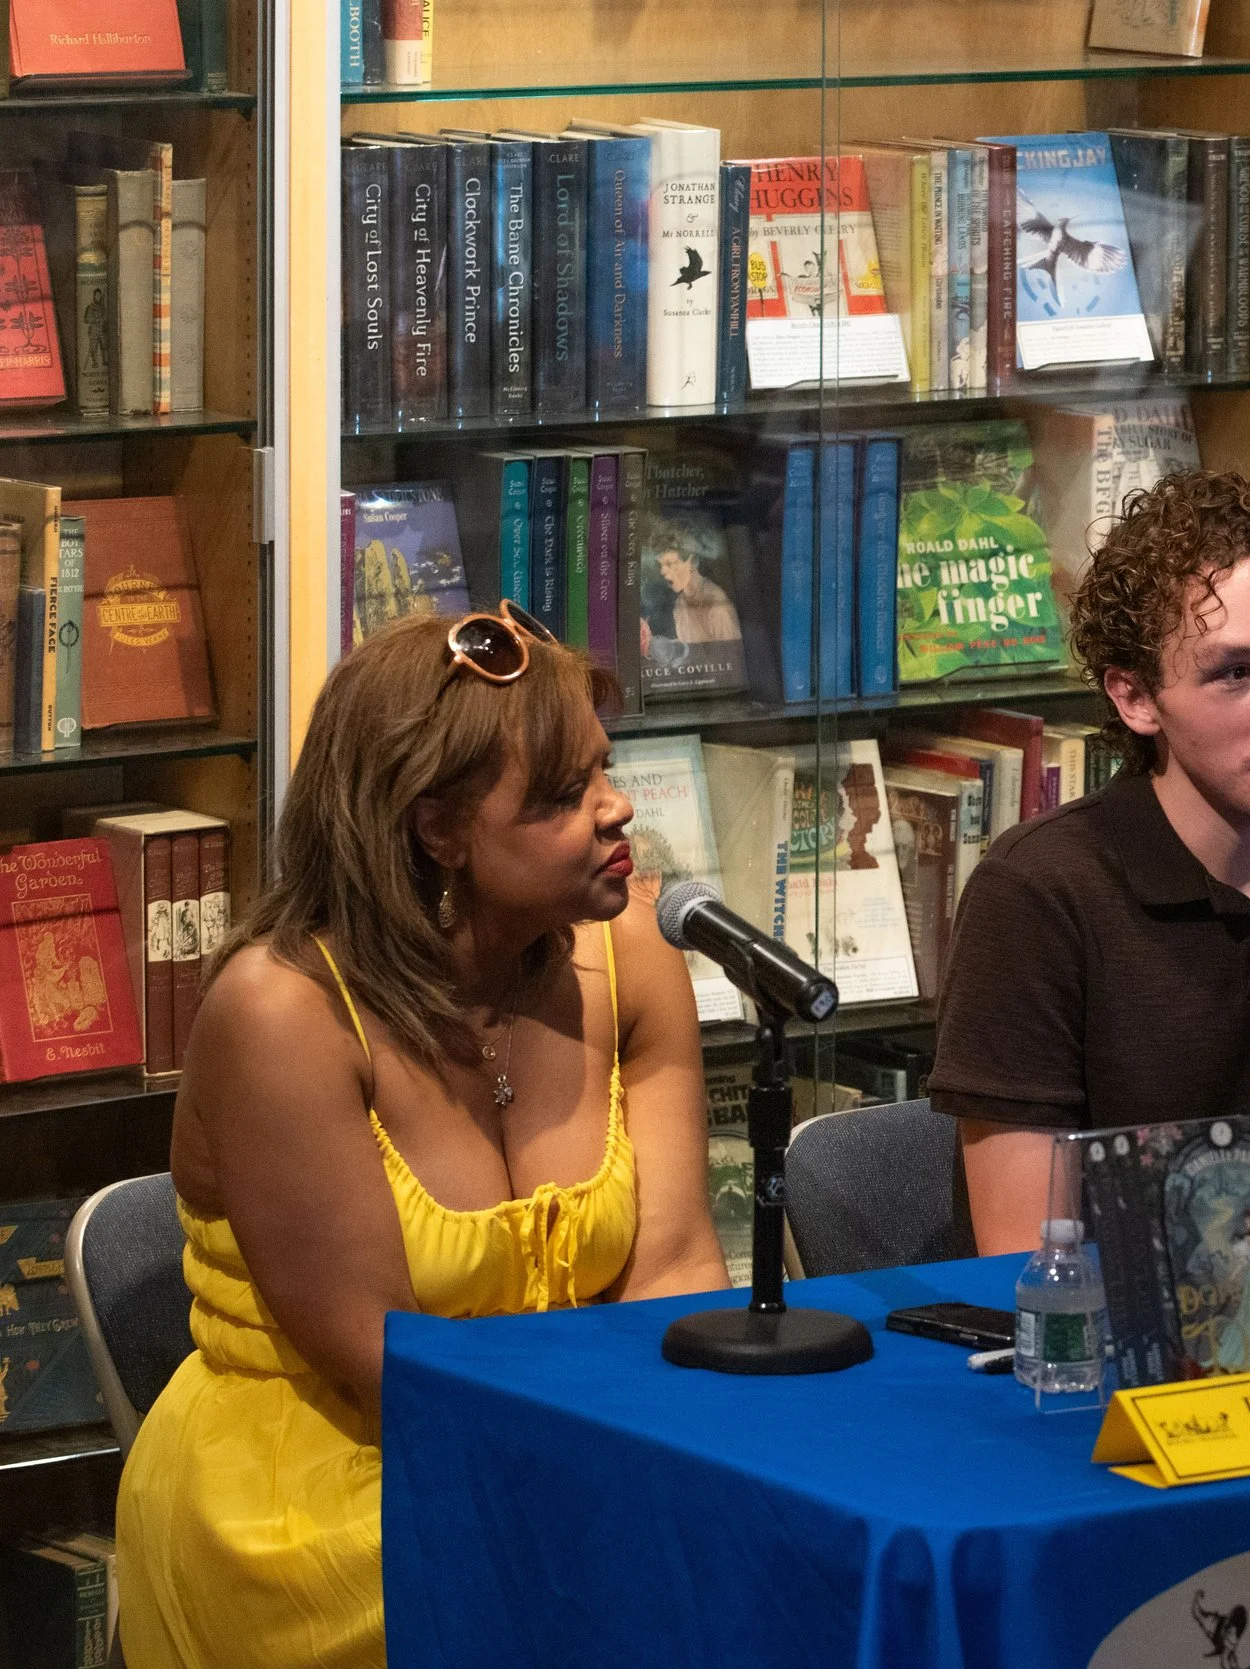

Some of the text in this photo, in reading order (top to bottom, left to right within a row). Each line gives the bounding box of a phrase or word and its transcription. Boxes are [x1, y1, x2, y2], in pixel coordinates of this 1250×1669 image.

[49, 32, 151, 45] Richard Halliburton
[550, 153, 580, 163] CLARE
[1016, 146, 1107, 171] CKINGJAY
[755, 162, 840, 183] HENRY
[663, 182, 716, 193] JONATHAN
[750, 187, 853, 209] HUGGINS
[663, 194, 716, 205] STRANGE
[934, 172, 943, 245] THE PRINCE WAITING
[686, 213, 699, 223] &
[972, 200, 981, 246] THE SPIRITS
[662, 229, 716, 238] Mr NORRELL
[748, 229, 759, 240] by
[763, 225, 812, 237] BEVERLY
[361, 183, 383, 350] City of Lost Souls
[465, 177, 481, 343] Clockwork Prince
[556, 174, 575, 361] Lord of Shadows
[613, 169, 626, 358] Queen of Air and Darkness
[750, 259, 767, 271] BUS
[1003, 209, 1012, 320] CATCHING FIRE
[411, 183, 431, 377] City of Heavenly Fire
[508, 183, 524, 373] The Bane Chronicles
[750, 270, 768, 281] STOP
[730, 236, 741, 338] GIRL FROM YAMHILL
[663, 308, 712, 316] Susanna Clarke
[1128, 437, 1171, 451] SUGAR
[1096, 426, 1112, 514] The BFG
[656, 483, 709, 499] Hatcher
[363, 511, 407, 523] Susan Cooper
[600, 512, 611, 541] Silver
[513, 518, 523, 544] Over
[58, 548, 84, 558] TARS
[907, 536, 999, 554] ROALD DAHL
[61, 568, 80, 578] 1812
[64, 559, 76, 567] OF
[542, 515, 555, 612] The Dark is Rising
[897, 544, 1037, 592] he magic
[624, 562, 637, 586] King
[600, 578, 611, 600] Tree
[48, 577, 58, 653] FIERCE FACE
[102, 605, 177, 623] CENTRE EARTH
[937, 587, 1043, 632] finger
[115, 629, 168, 645] JULES VERNE
[678, 661, 734, 675] COVILLE
[1069, 749, 1078, 772] THIS
[632, 773, 663, 788] AND
[643, 785, 688, 800] PEACH
[636, 807, 665, 818] DAHL
[17, 847, 104, 872] Wonderful
[15, 869, 84, 899] Garden
[772, 840, 789, 944] THE WITCH
[61, 1042, 106, 1060] Nesbit
